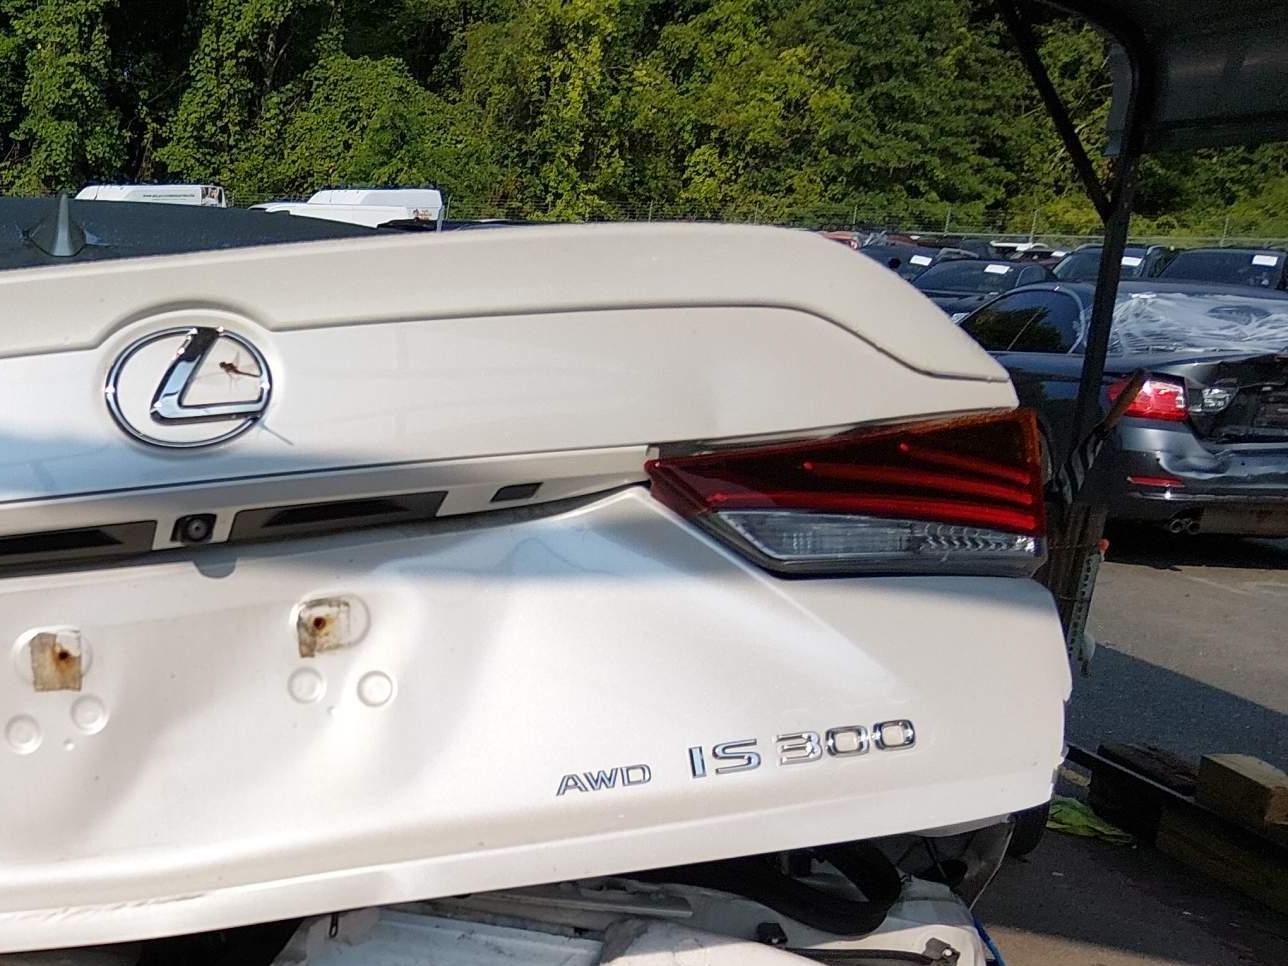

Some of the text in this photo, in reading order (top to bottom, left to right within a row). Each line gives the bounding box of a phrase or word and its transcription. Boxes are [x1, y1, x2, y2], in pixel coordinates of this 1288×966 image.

[555, 719, 917, 797] AWD IS 300
